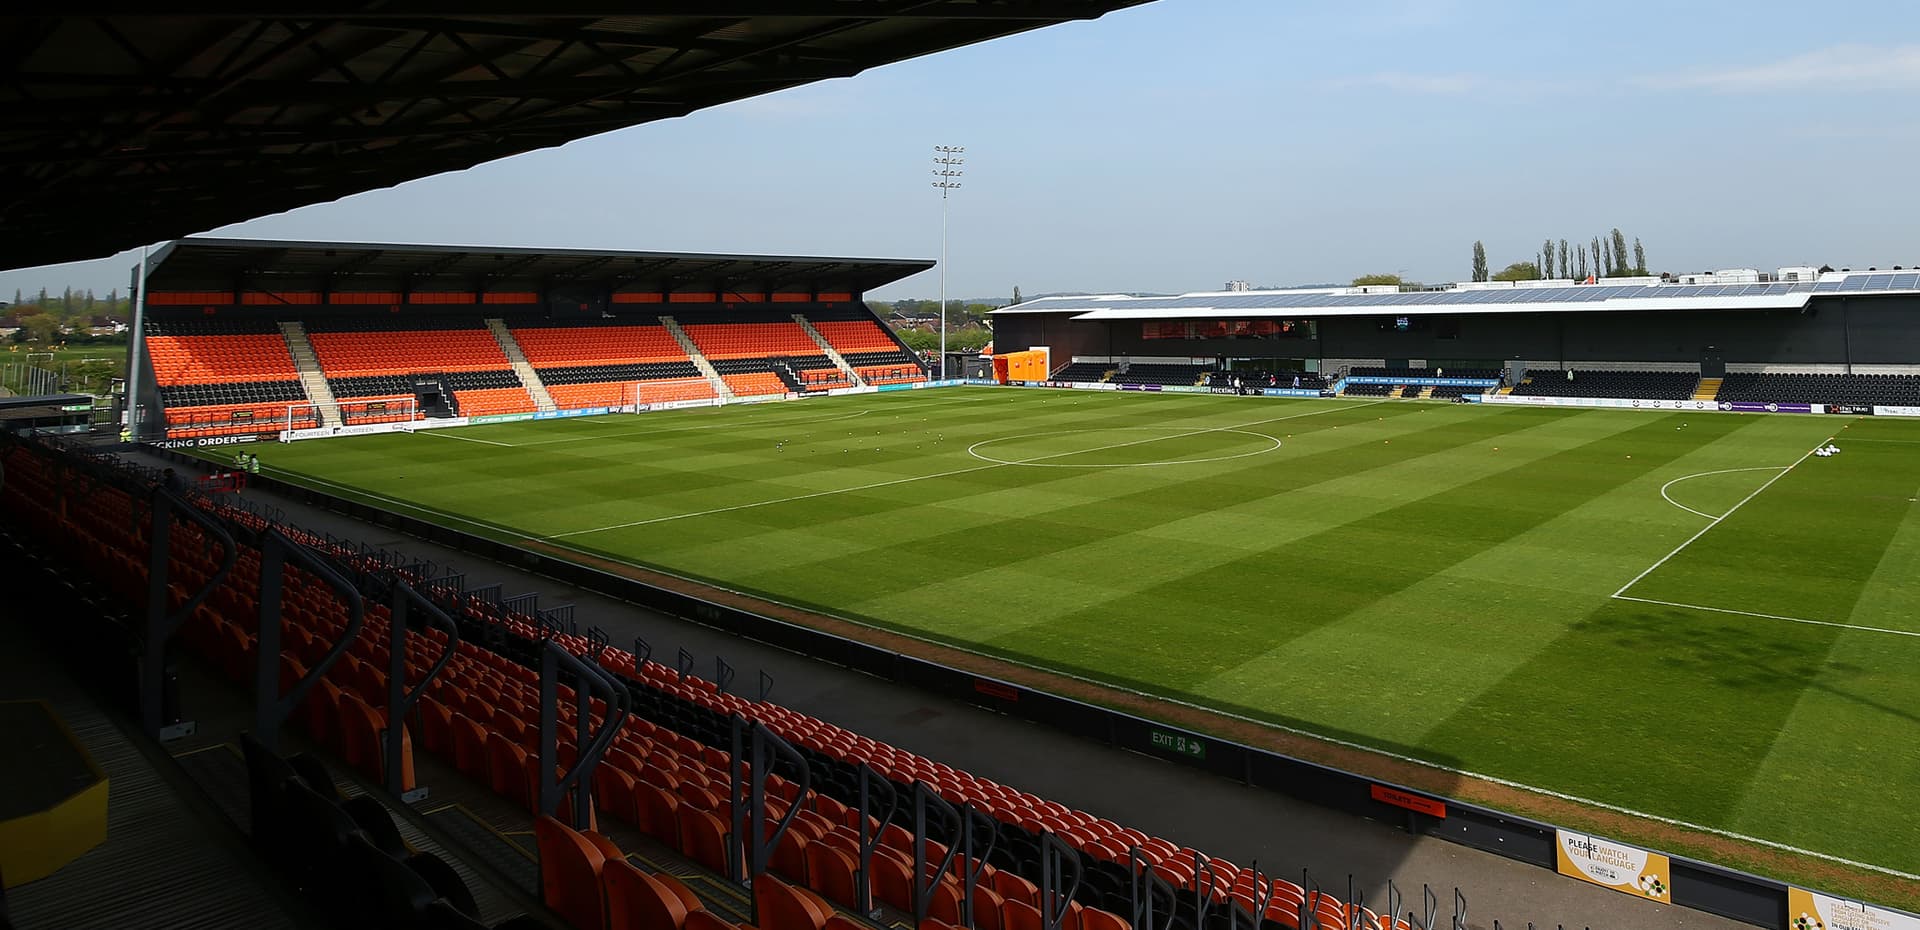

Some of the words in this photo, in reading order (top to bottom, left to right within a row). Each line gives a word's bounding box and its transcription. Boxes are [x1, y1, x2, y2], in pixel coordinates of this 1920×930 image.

[198, 436, 238, 446] ORDER
[1152, 732, 1173, 747] EXIT
[1568, 838, 1598, 853] PLEASE
[1599, 847, 1629, 861] WATCH
[1592, 852, 1637, 872] LANGUAGE
